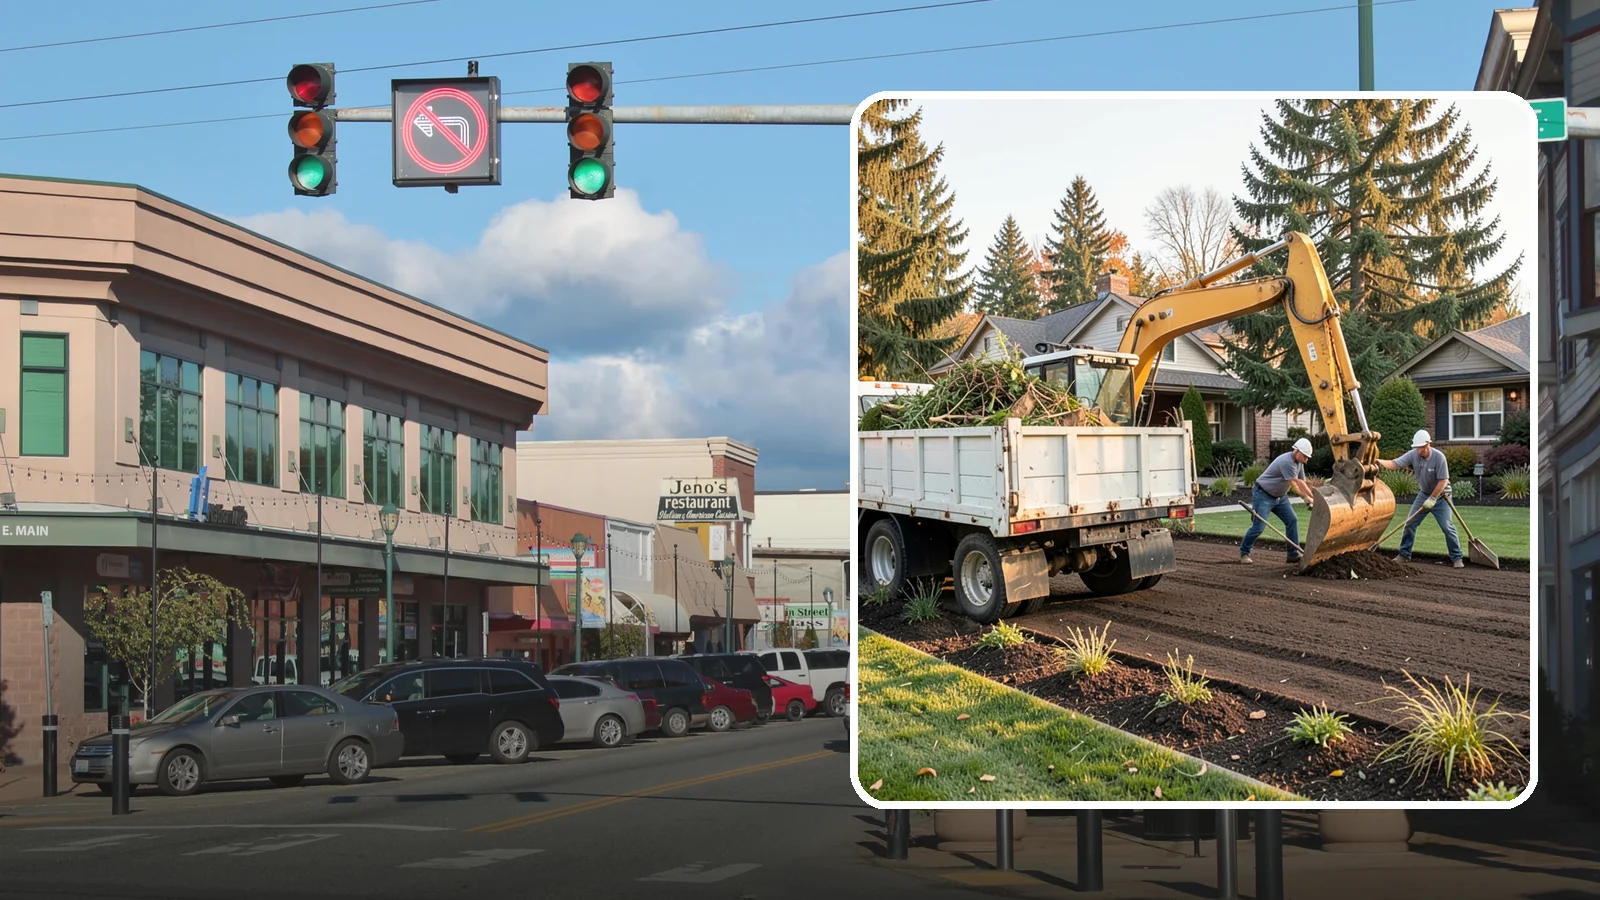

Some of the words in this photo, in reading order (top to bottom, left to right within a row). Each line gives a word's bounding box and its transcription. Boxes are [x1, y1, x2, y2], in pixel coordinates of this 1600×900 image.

[669, 480, 727, 494] Jeno's
[665, 496, 731, 509] restaurant
[659, 510, 681, 519] Italian
[686, 510, 715, 519] American
[715, 509, 737, 519] Cuisine
[2, 525, 13, 536] E.
[15, 525, 49, 536] MAIN
[798, 607, 828, 617] Street
[791, 619, 823, 627] lass
